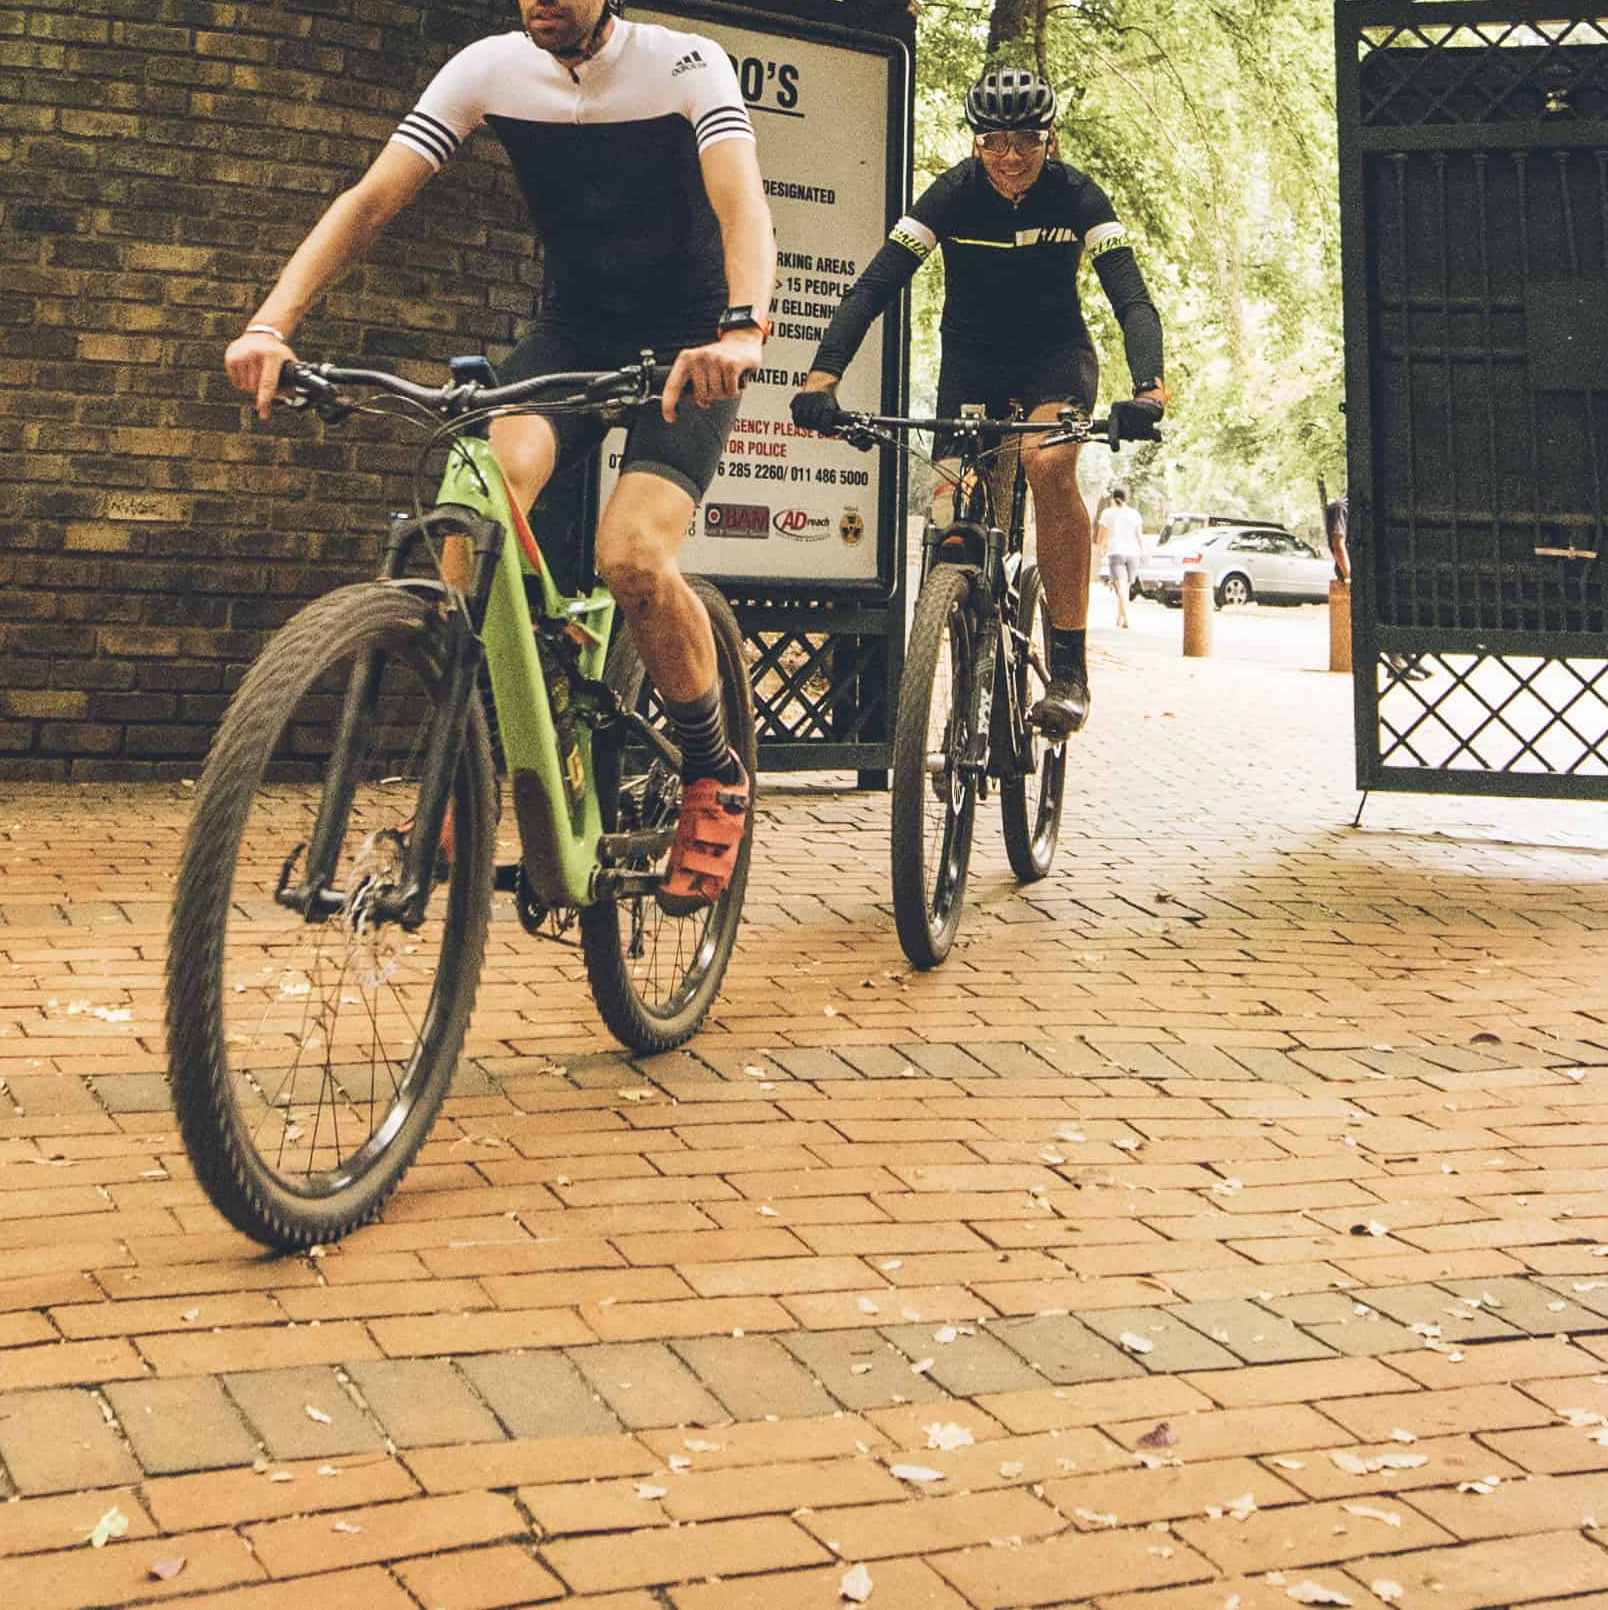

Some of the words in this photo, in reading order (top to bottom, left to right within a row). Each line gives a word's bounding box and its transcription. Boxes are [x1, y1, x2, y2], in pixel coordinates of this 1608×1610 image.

[762, 180, 836, 204] DESIGNATED
[816, 257, 856, 276] AREAS
[787, 277, 801, 292] 15
[748, 442, 787, 458] POLICE
[729, 462, 751, 478] 285
[791, 465, 811, 482] 011
[816, 468, 837, 484] 486
[840, 471, 869, 486] 5000
